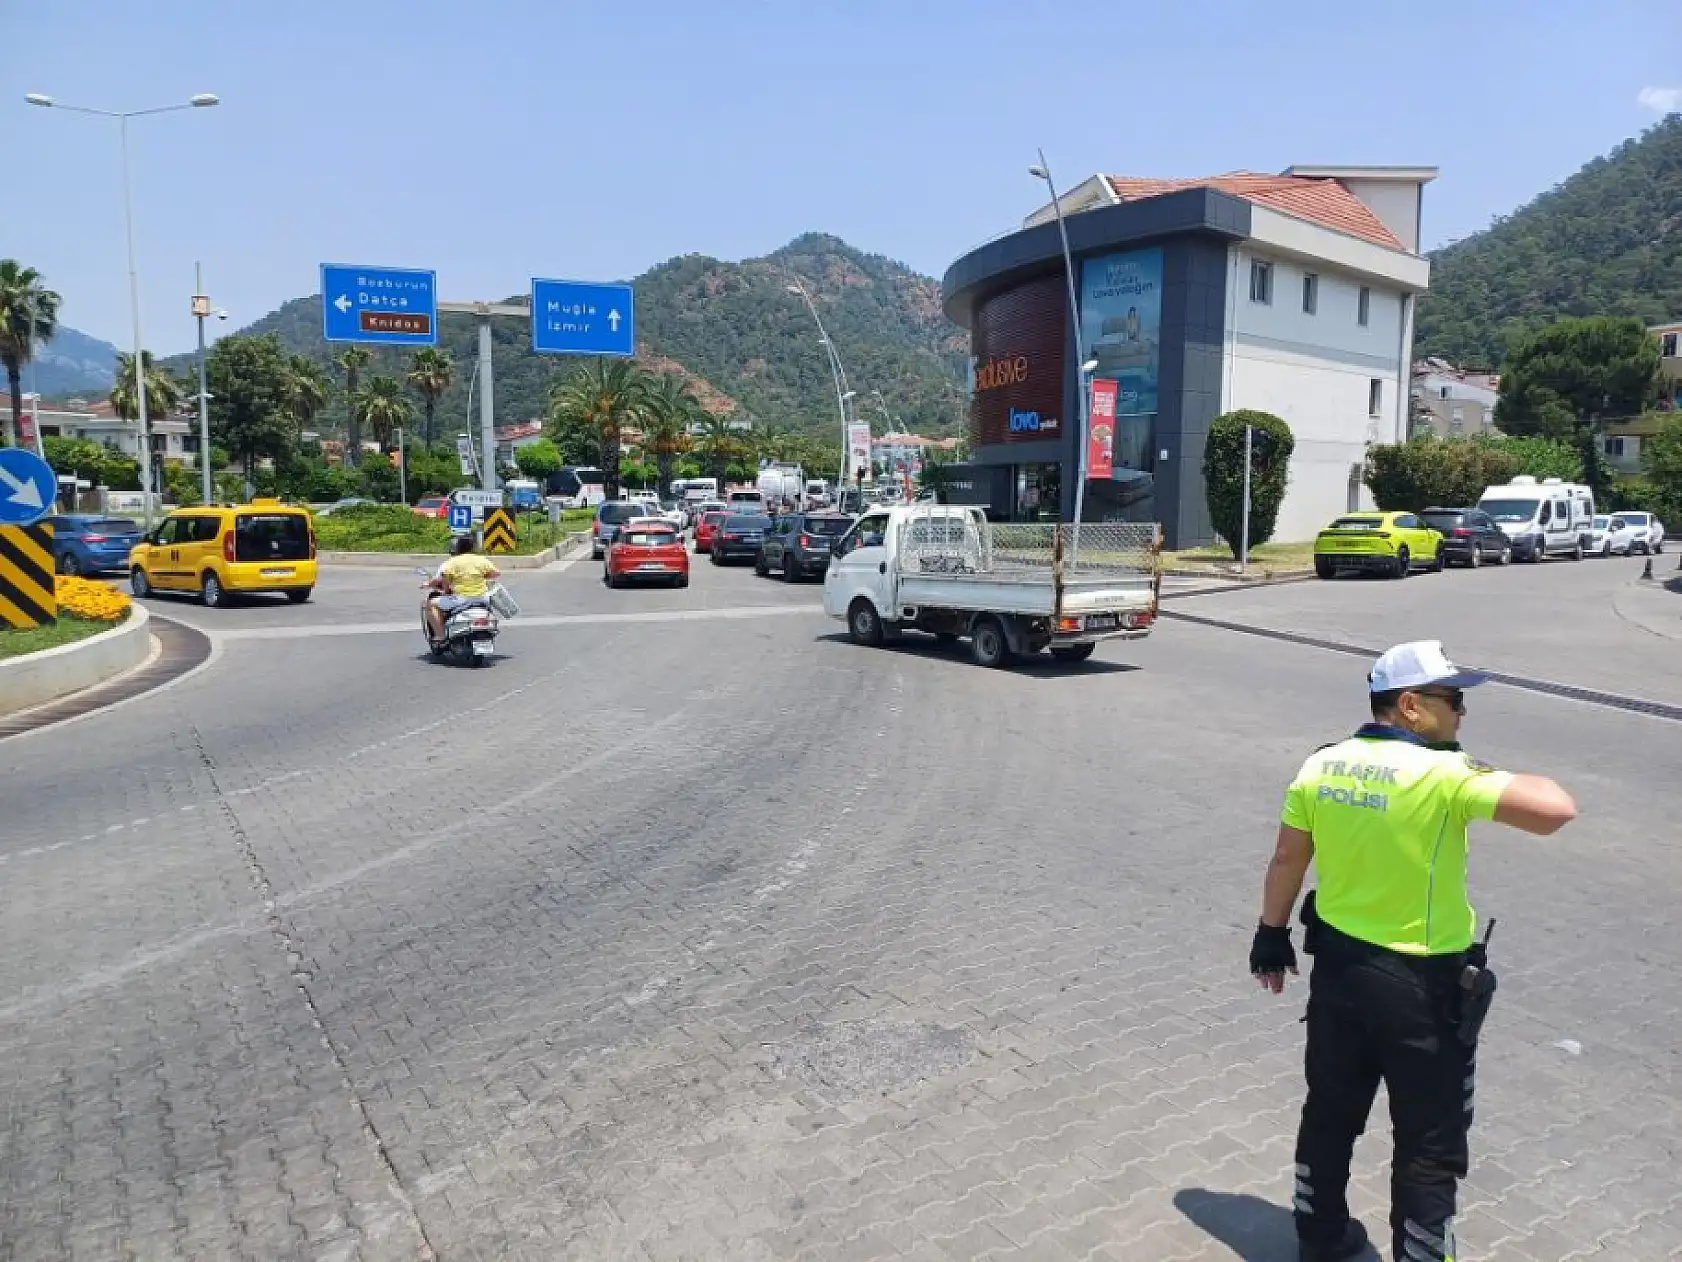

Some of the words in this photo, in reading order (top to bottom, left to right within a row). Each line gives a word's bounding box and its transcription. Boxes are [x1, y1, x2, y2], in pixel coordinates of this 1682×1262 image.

[357, 276, 428, 291] Bozburun
[369, 316, 421, 329] Knidos
[454, 508, 467, 525] H
